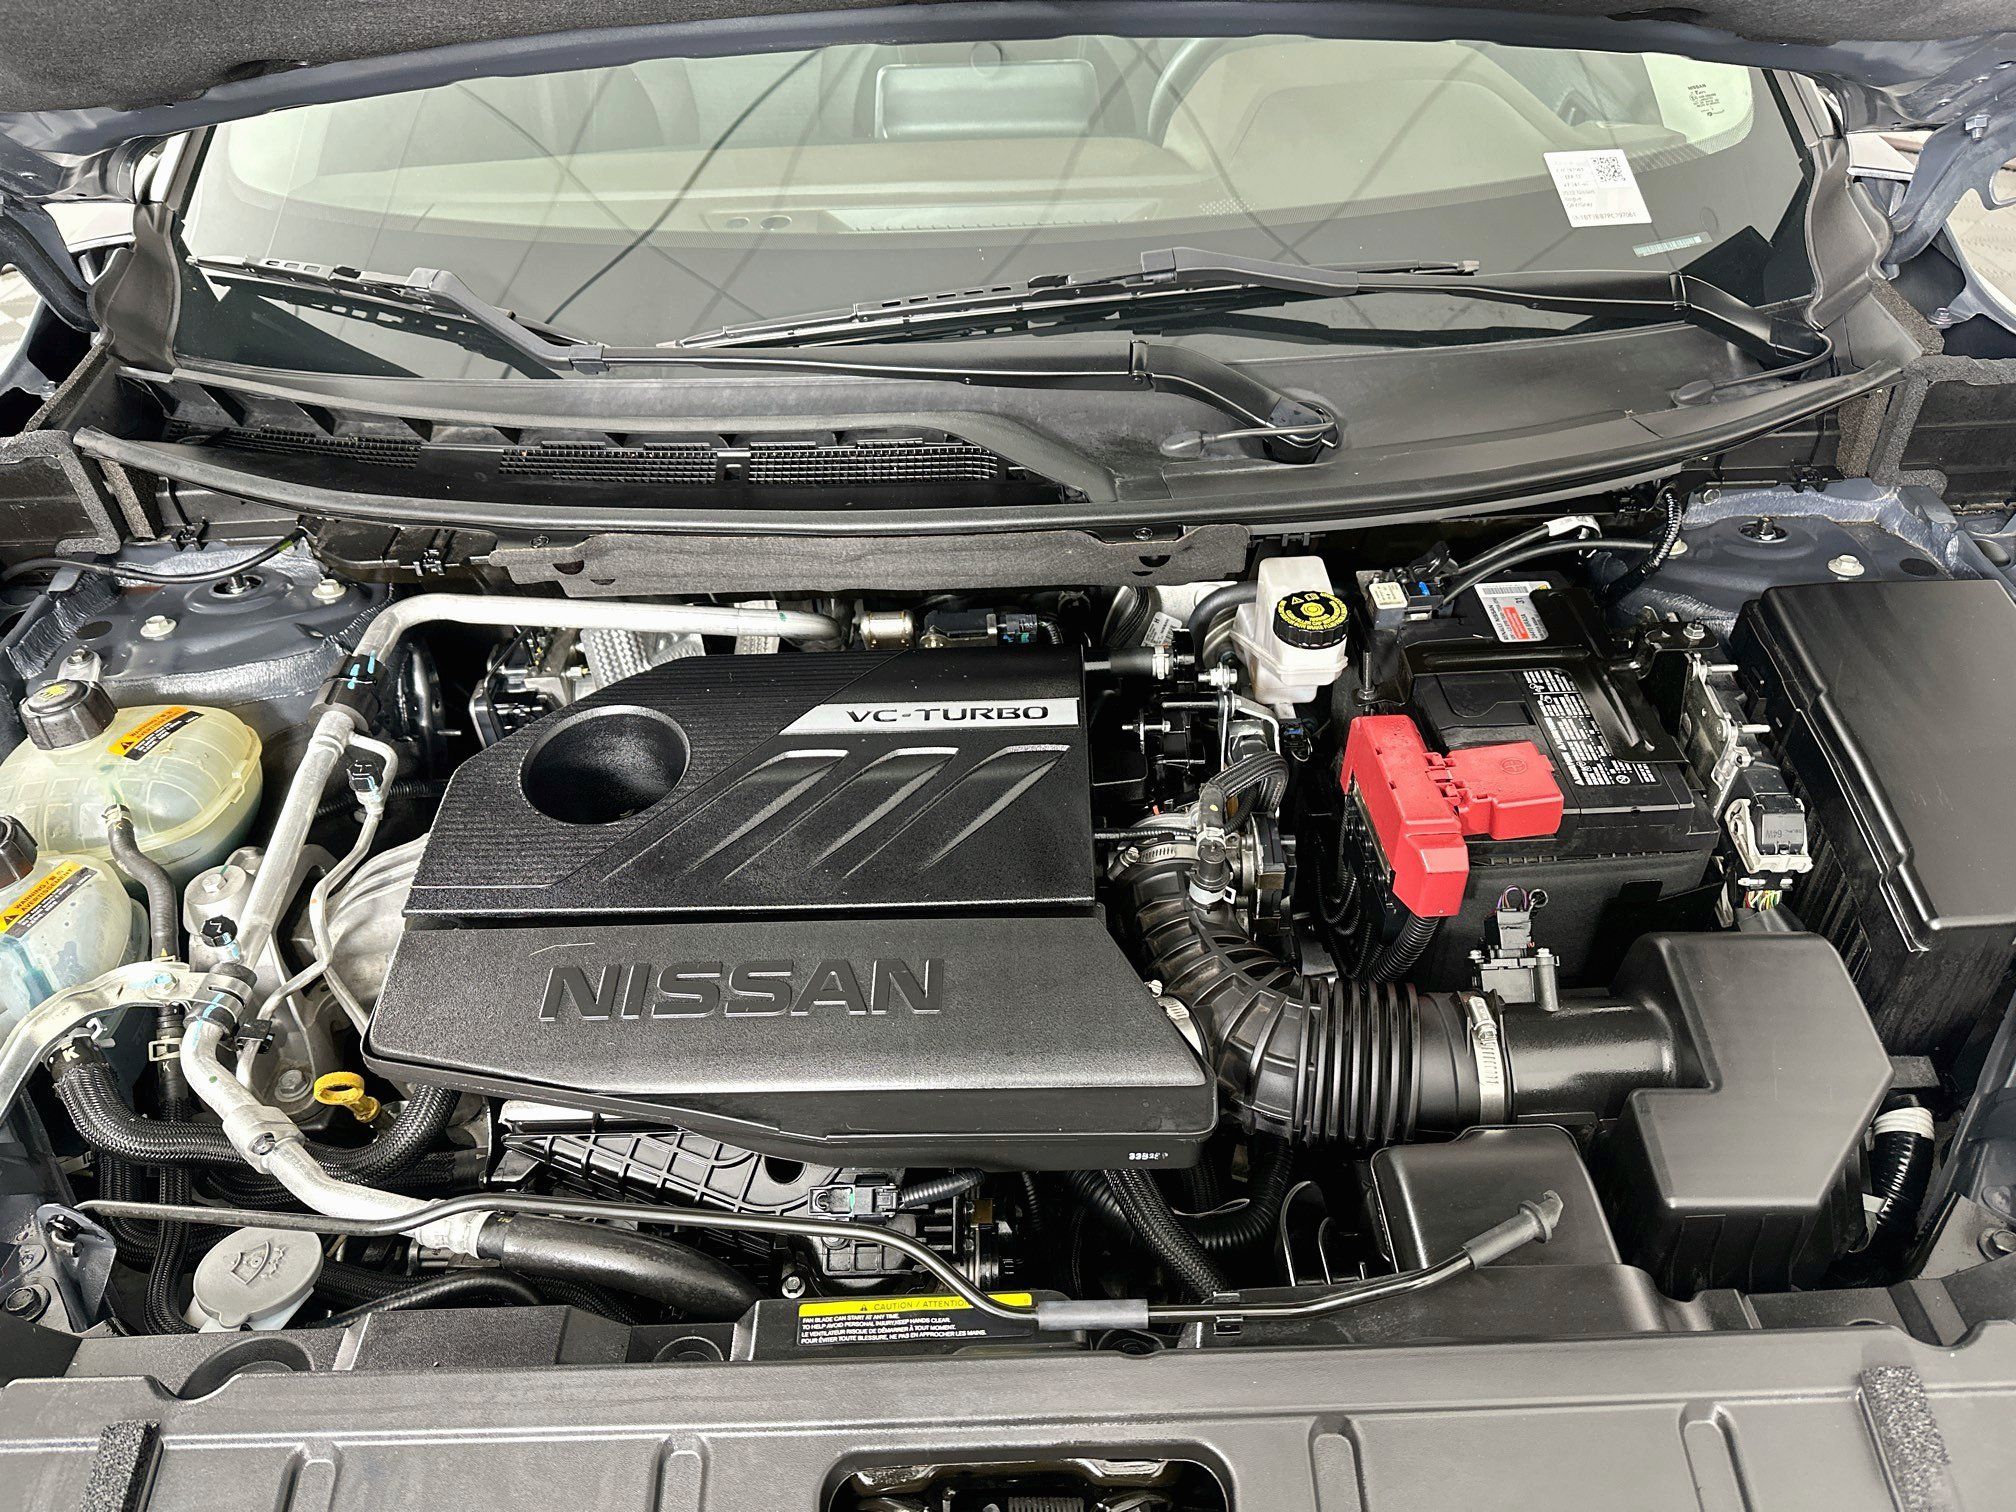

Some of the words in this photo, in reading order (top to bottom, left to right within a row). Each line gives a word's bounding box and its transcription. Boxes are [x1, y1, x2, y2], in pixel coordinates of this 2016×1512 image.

[845, 705, 1050, 723] VC-TURBO
[14, 883, 45, 910] WARNING
[21, 868, 74, 912] AVERTISSEMENT
[538, 957, 946, 1023] NISSAN
[62, 1046, 80, 1062] K
[162, 1060, 171, 1072] K
[874, 1302, 913, 1311] CAUTION
[810, 1329, 846, 1338] VENTILATEUR
[877, 1326, 909, 1334] DÉMARRER
